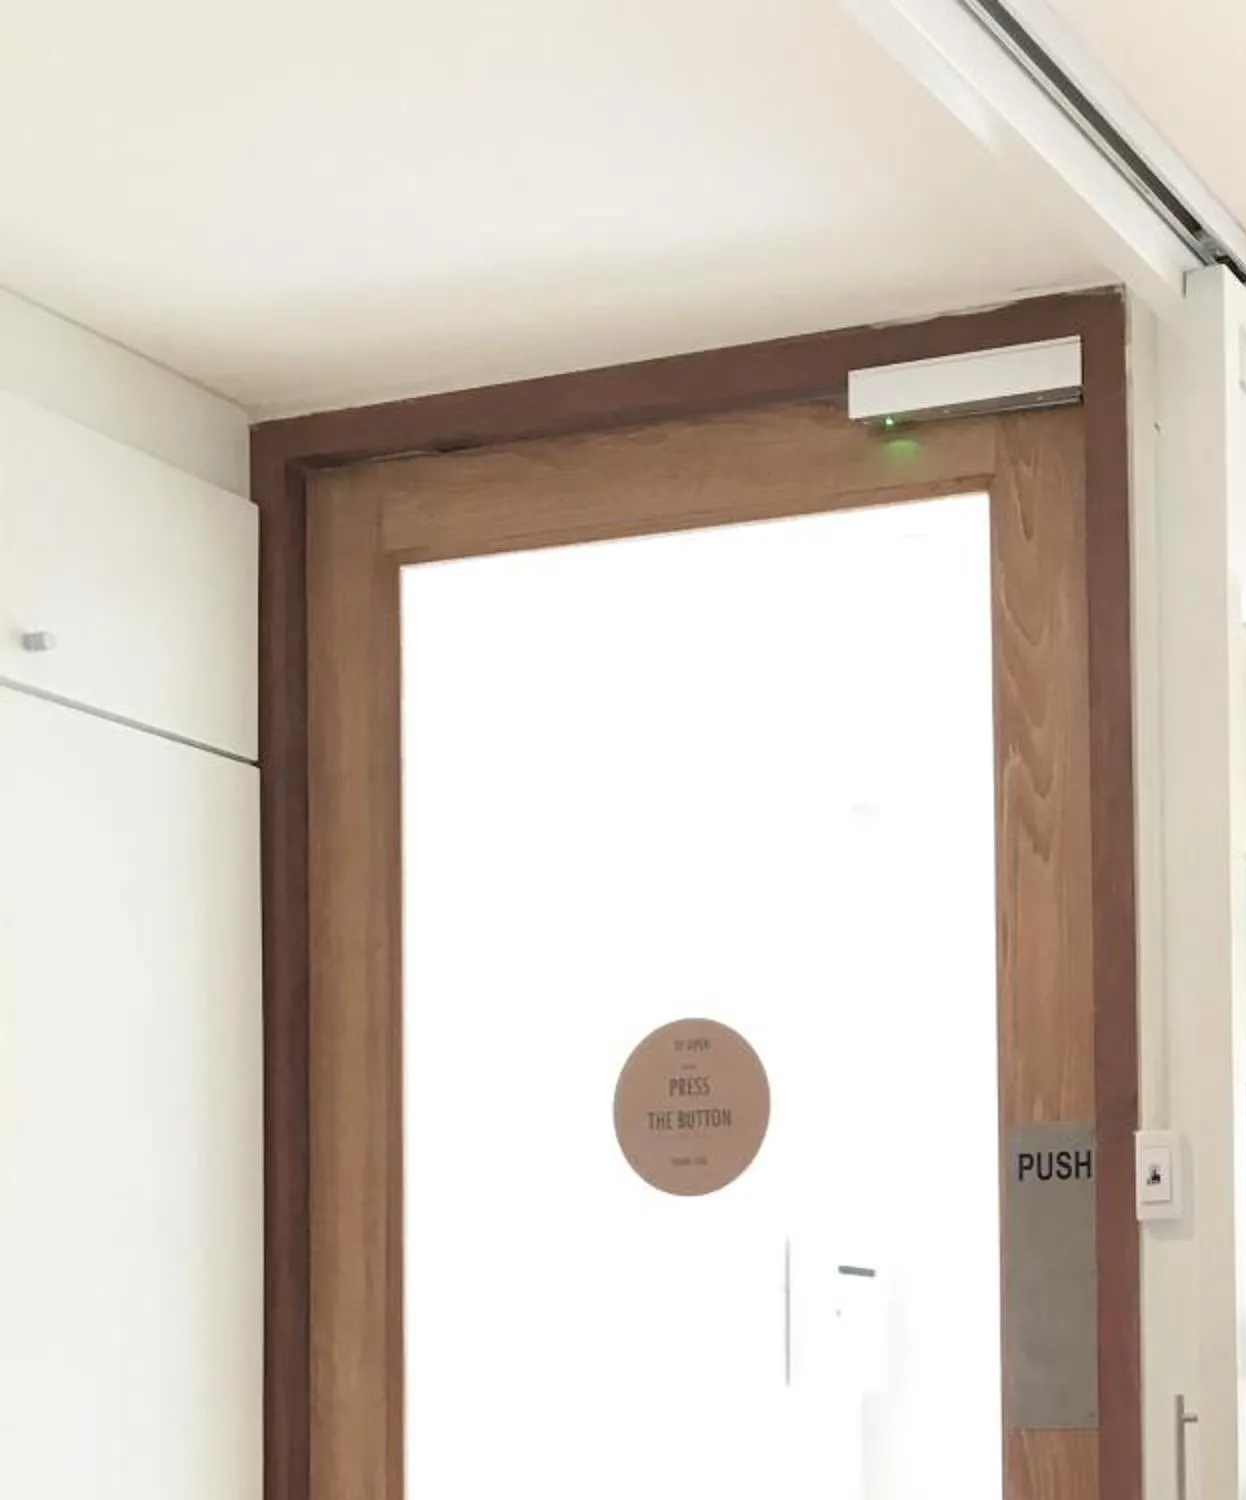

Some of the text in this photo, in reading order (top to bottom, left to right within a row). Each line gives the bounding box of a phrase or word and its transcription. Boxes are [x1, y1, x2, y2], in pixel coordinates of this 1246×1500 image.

[669, 1076, 710, 1097] PRESS
[648, 1108, 732, 1131] THE BUTTON
[1018, 1150, 1093, 1181] PUSH
